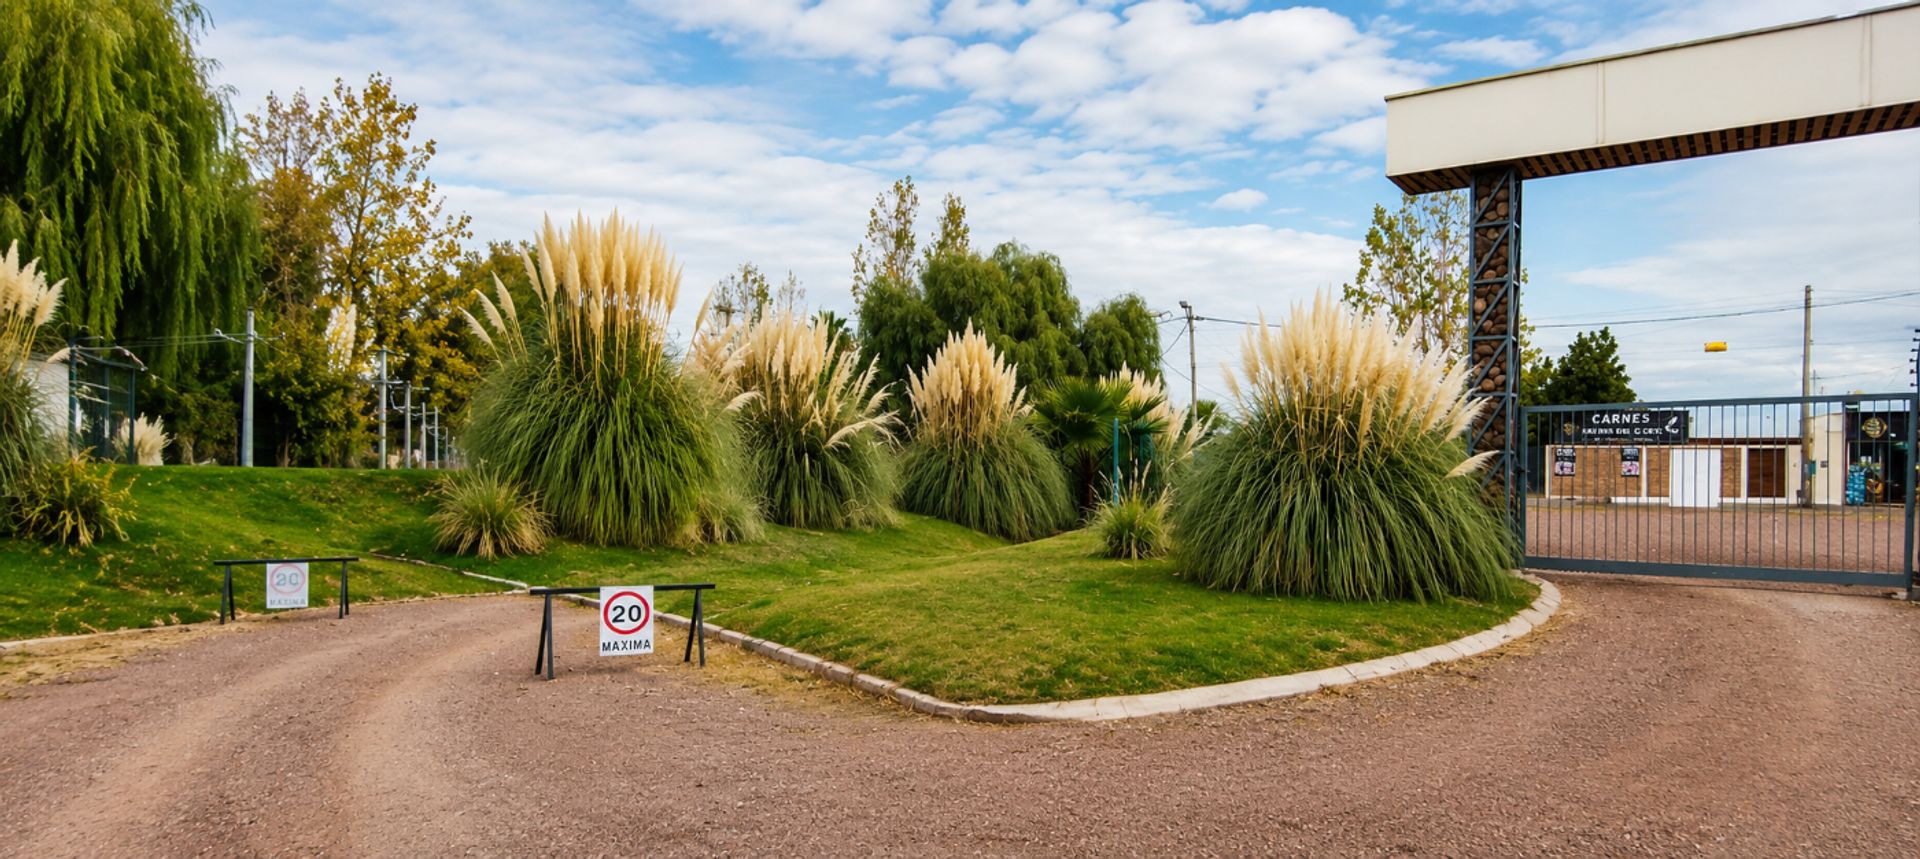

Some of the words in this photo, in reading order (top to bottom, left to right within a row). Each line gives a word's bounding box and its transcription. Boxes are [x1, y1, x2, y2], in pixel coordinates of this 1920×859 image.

[1592, 413, 1650, 424] CARNES
[276, 572, 299, 586] 20
[612, 604, 642, 623] 20
[602, 639, 651, 652] MAXIMA
